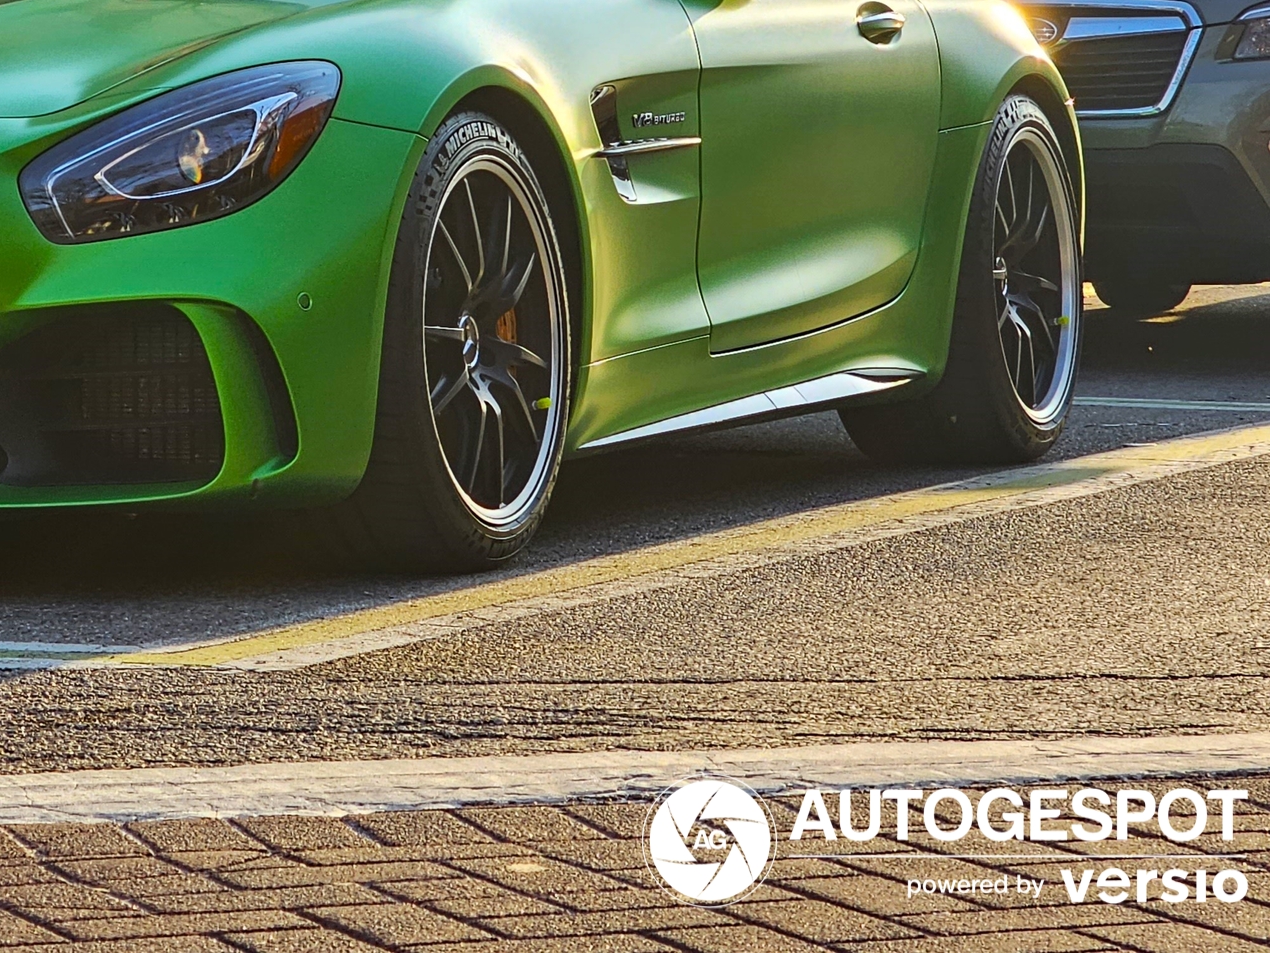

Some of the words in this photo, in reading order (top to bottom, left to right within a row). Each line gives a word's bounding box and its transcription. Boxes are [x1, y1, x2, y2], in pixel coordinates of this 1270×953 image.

[632, 112, 653, 128] V8
[654, 112, 685, 125] BITURBO
[446, 121, 496, 157] MICHELIN
